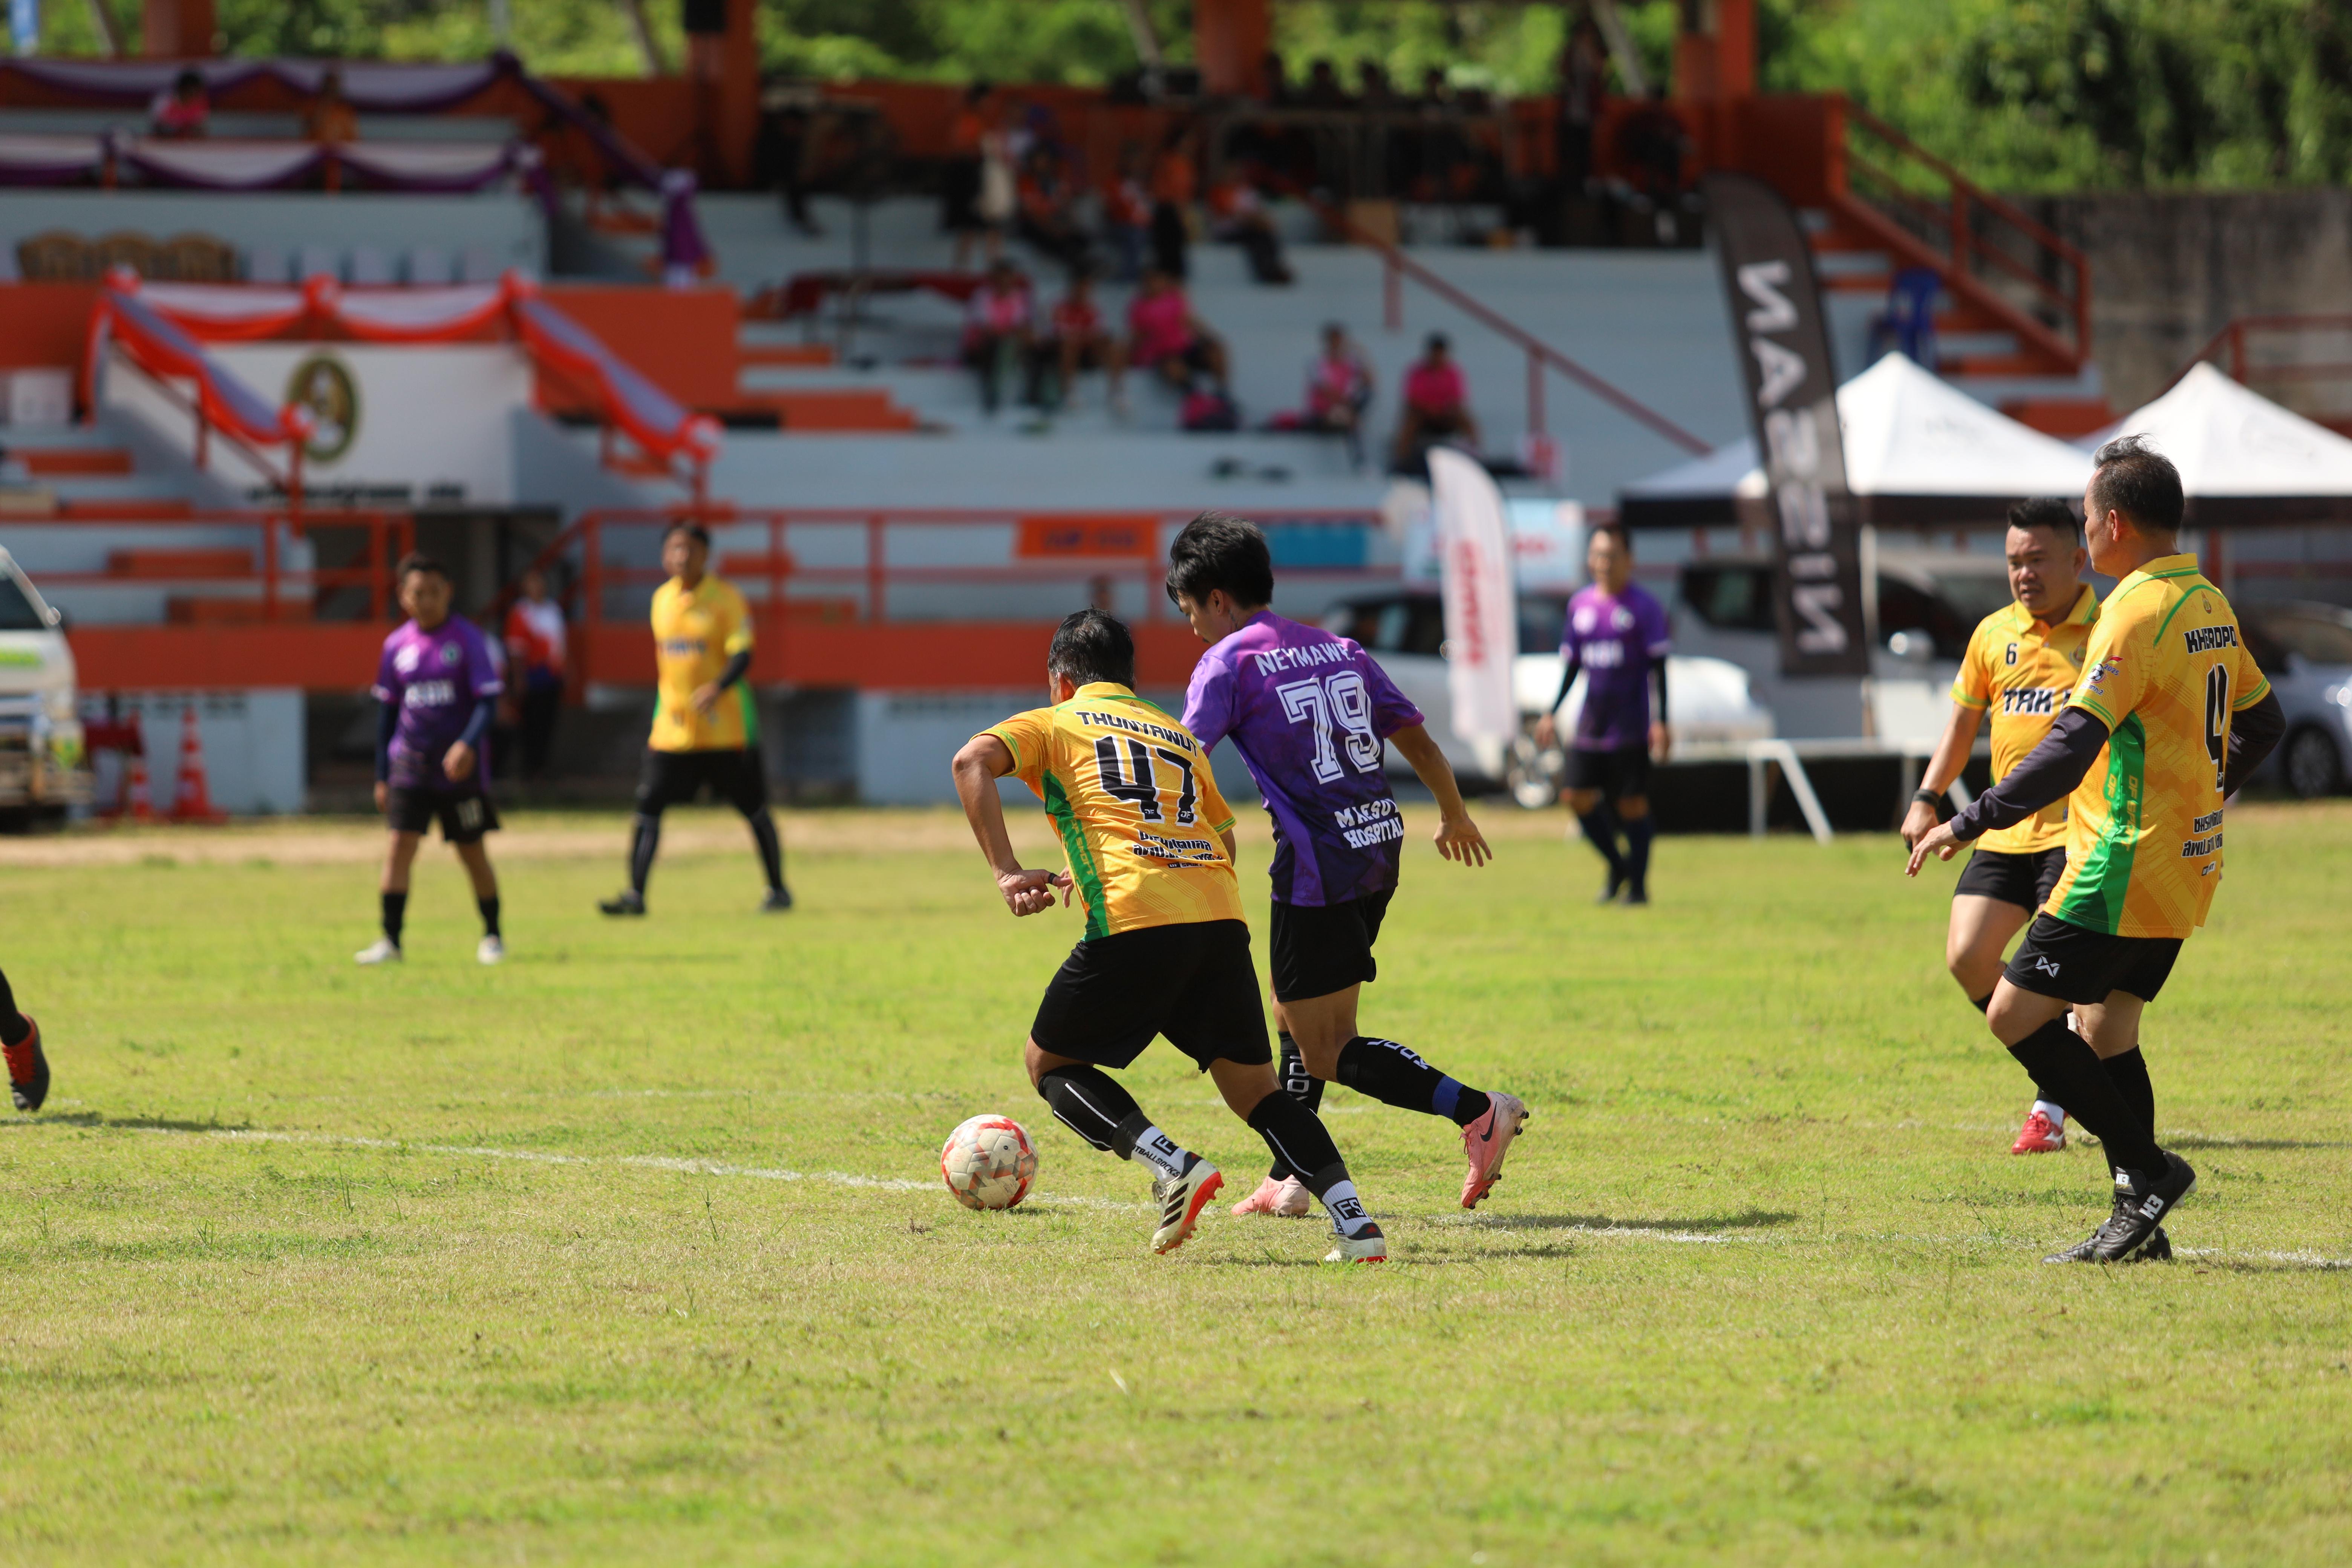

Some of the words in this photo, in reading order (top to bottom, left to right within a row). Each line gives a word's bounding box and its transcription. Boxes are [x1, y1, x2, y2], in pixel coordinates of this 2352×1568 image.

[2006, 642, 2018, 666] 6
[2184, 625, 2239, 654] KHERDPO
[2104, 664, 2120, 676] 2025
[1075, 711, 1198, 758] THUNYAWUT
[1275, 671, 1381, 784] 79
[1093, 735, 1200, 828] 47
[1343, 817, 1404, 849] HOSPITAL
[1336, 1199, 1364, 1219] FS
[2138, 1194, 2164, 1220] H3
